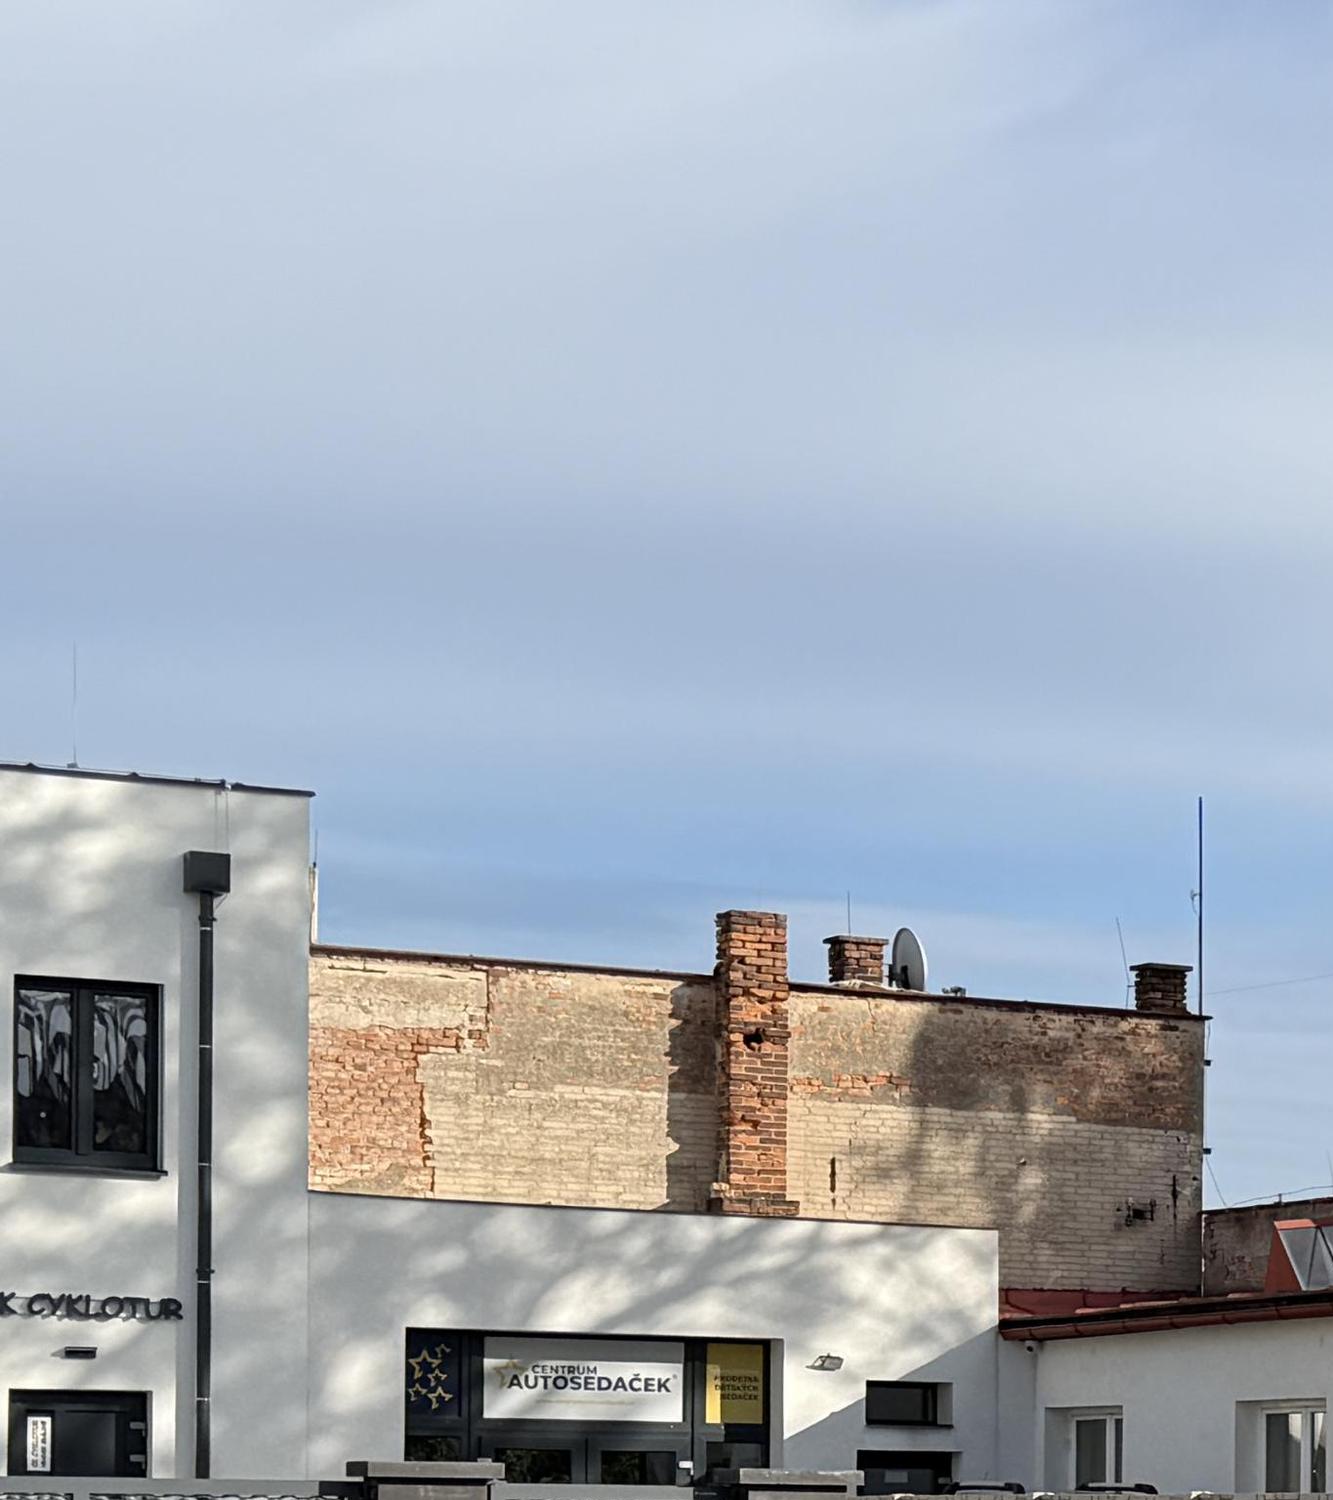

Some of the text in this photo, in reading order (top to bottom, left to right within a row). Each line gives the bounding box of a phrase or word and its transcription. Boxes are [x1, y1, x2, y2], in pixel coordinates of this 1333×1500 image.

[27, 1293, 183, 1321] CYKLOTUR
[531, 1363, 598, 1376] CENTRUM
[507, 1374, 671, 1394] AUTOSEDAČEK
